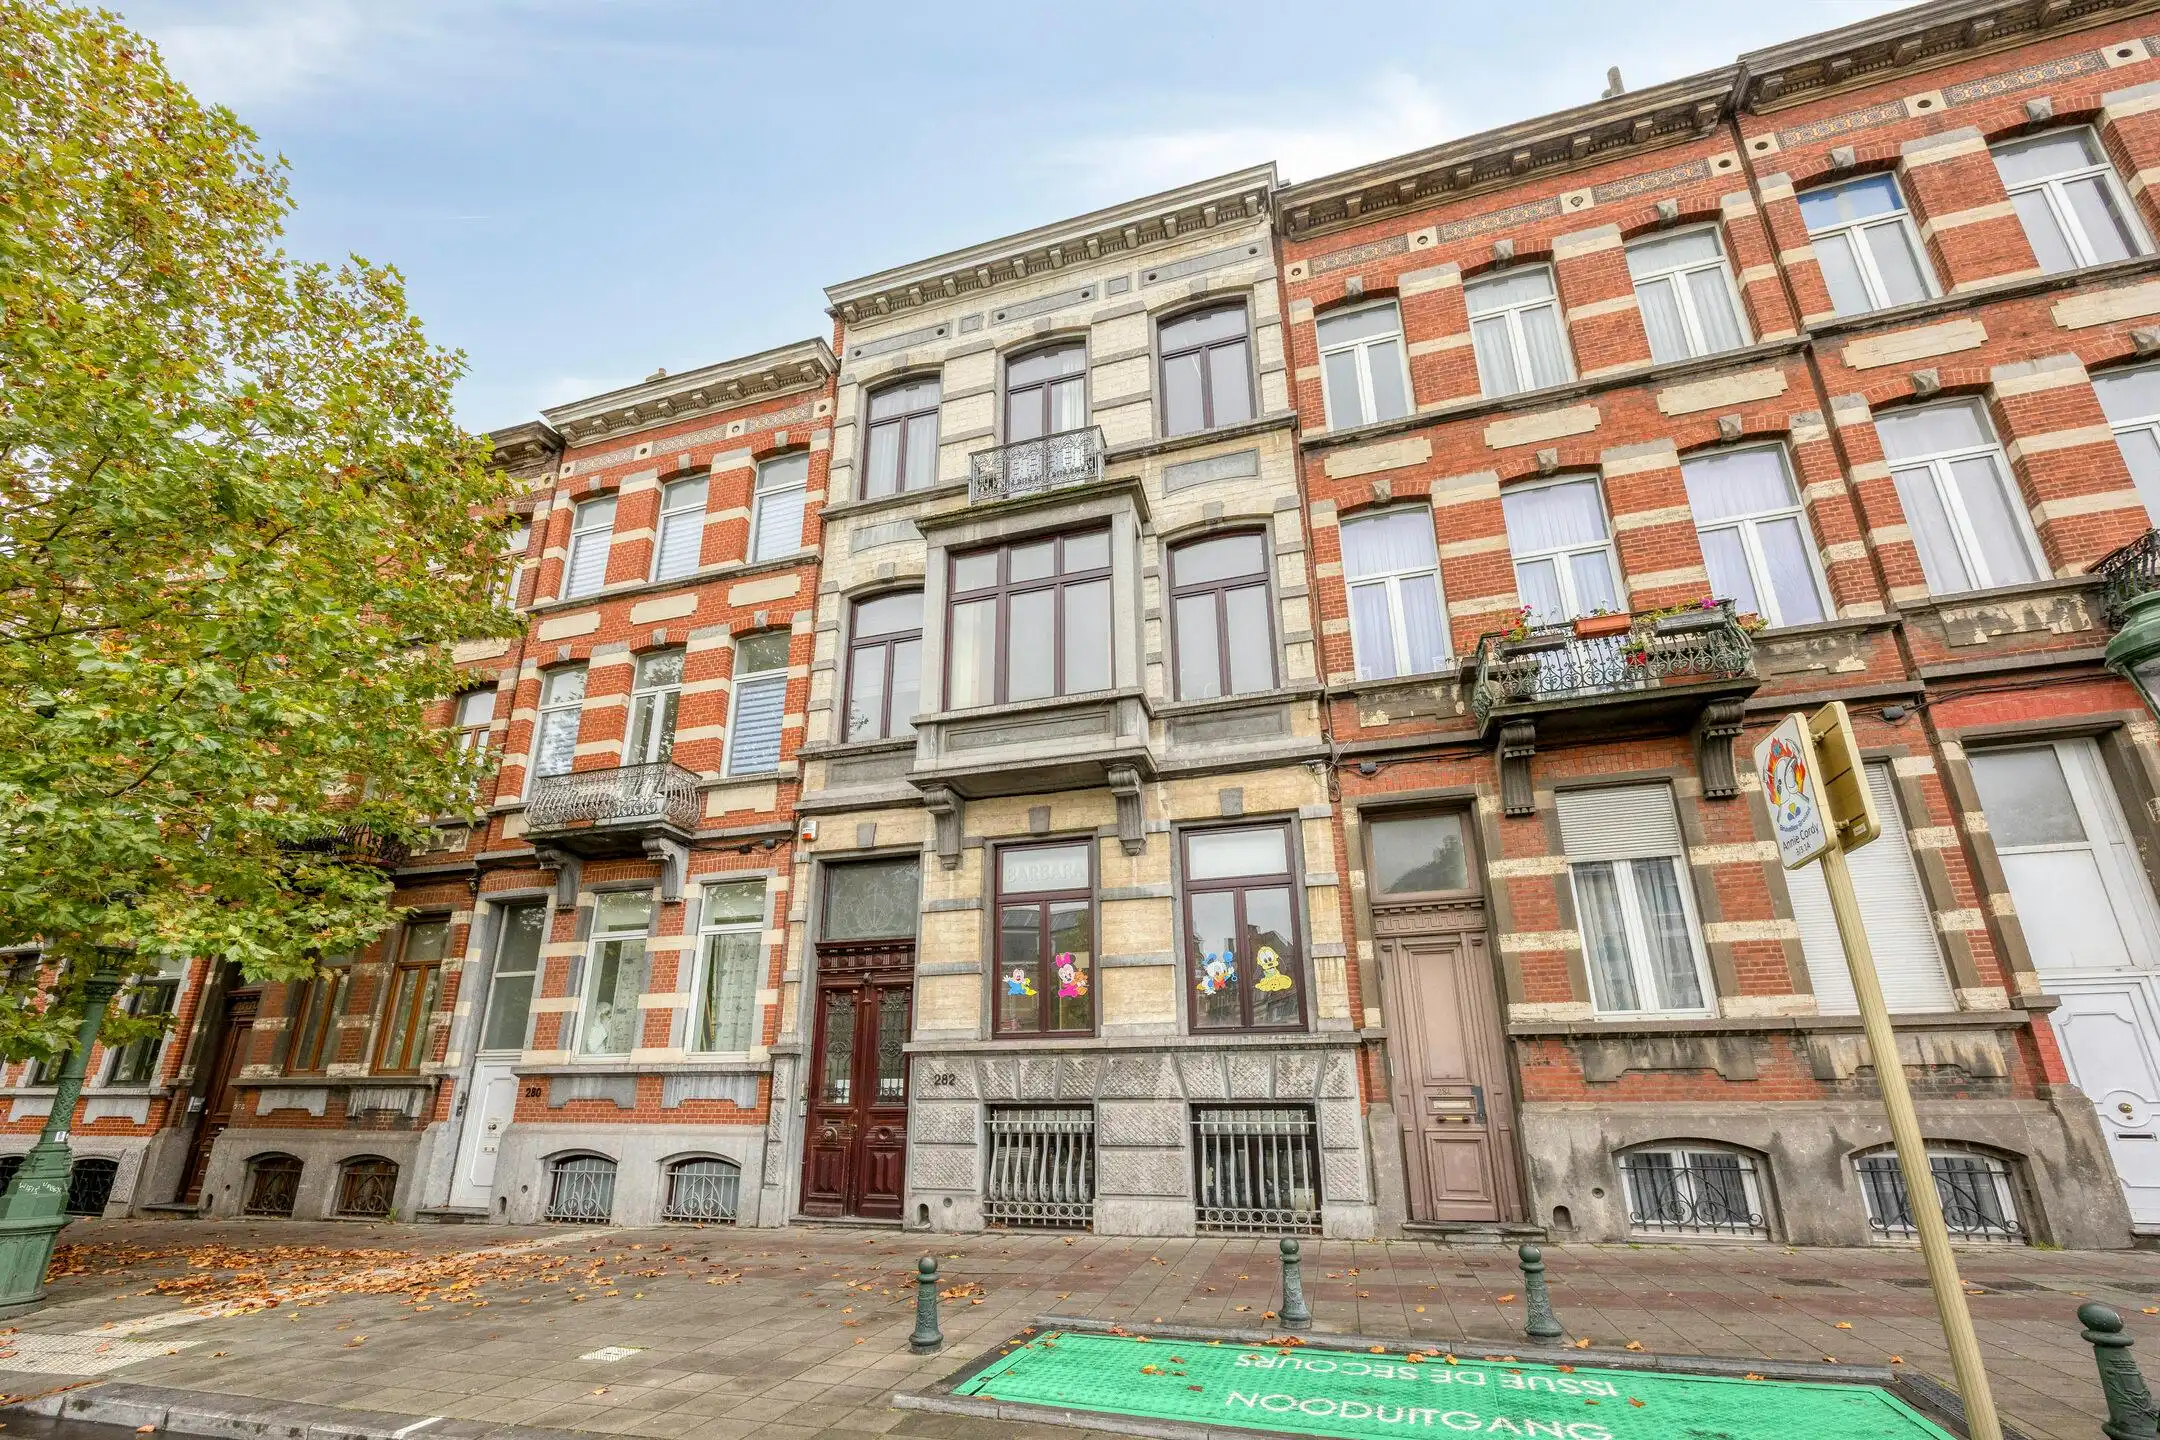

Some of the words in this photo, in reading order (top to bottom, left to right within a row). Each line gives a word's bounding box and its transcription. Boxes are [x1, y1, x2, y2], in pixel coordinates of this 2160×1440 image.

[1782, 835, 1800, 851] Annie
[1799, 822, 1819, 840] Cordy
[934, 1073, 956, 1086] 282
[525, 1087, 542, 1098] 280
[1235, 1354, 1418, 1380] SECOURS
[1430, 1368, 1486, 1386] DE
[1501, 1373, 1618, 1397] ISSUE
[1225, 1391, 1614, 1440] NOODUITGANG
